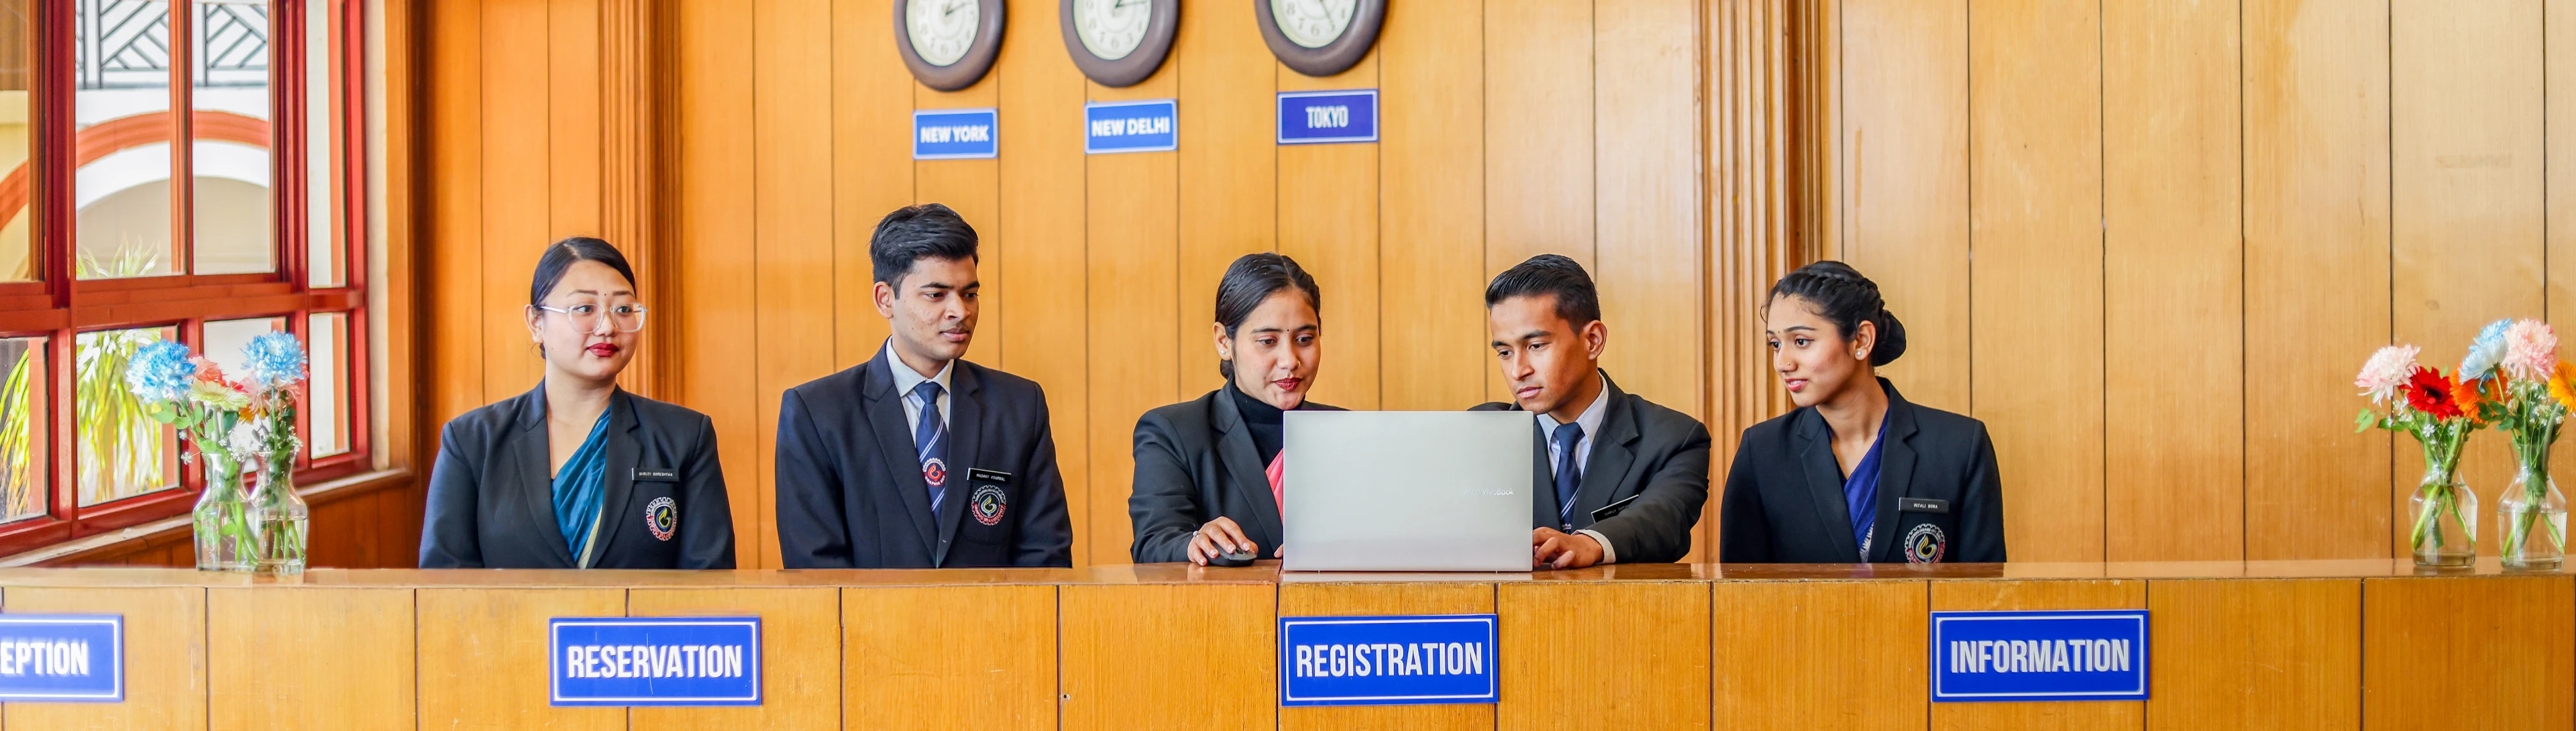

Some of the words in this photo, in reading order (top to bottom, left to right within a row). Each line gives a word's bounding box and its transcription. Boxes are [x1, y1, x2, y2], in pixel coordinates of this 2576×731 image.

[1091, 119, 1126, 137] NEW
[1127, 117, 1171, 135] DELHI
[1305, 106, 1348, 128] TOKYO
[920, 127, 952, 144] NEW
[953, 125, 989, 142] YORK
[1482, 488, 1514, 496] VivoBook
[0, 640, 90, 675] EPTION
[567, 644, 743, 677] RESERVATION
[1296, 642, 1483, 677] REGISTRATION
[1951, 640, 2130, 674] INFORMATION
